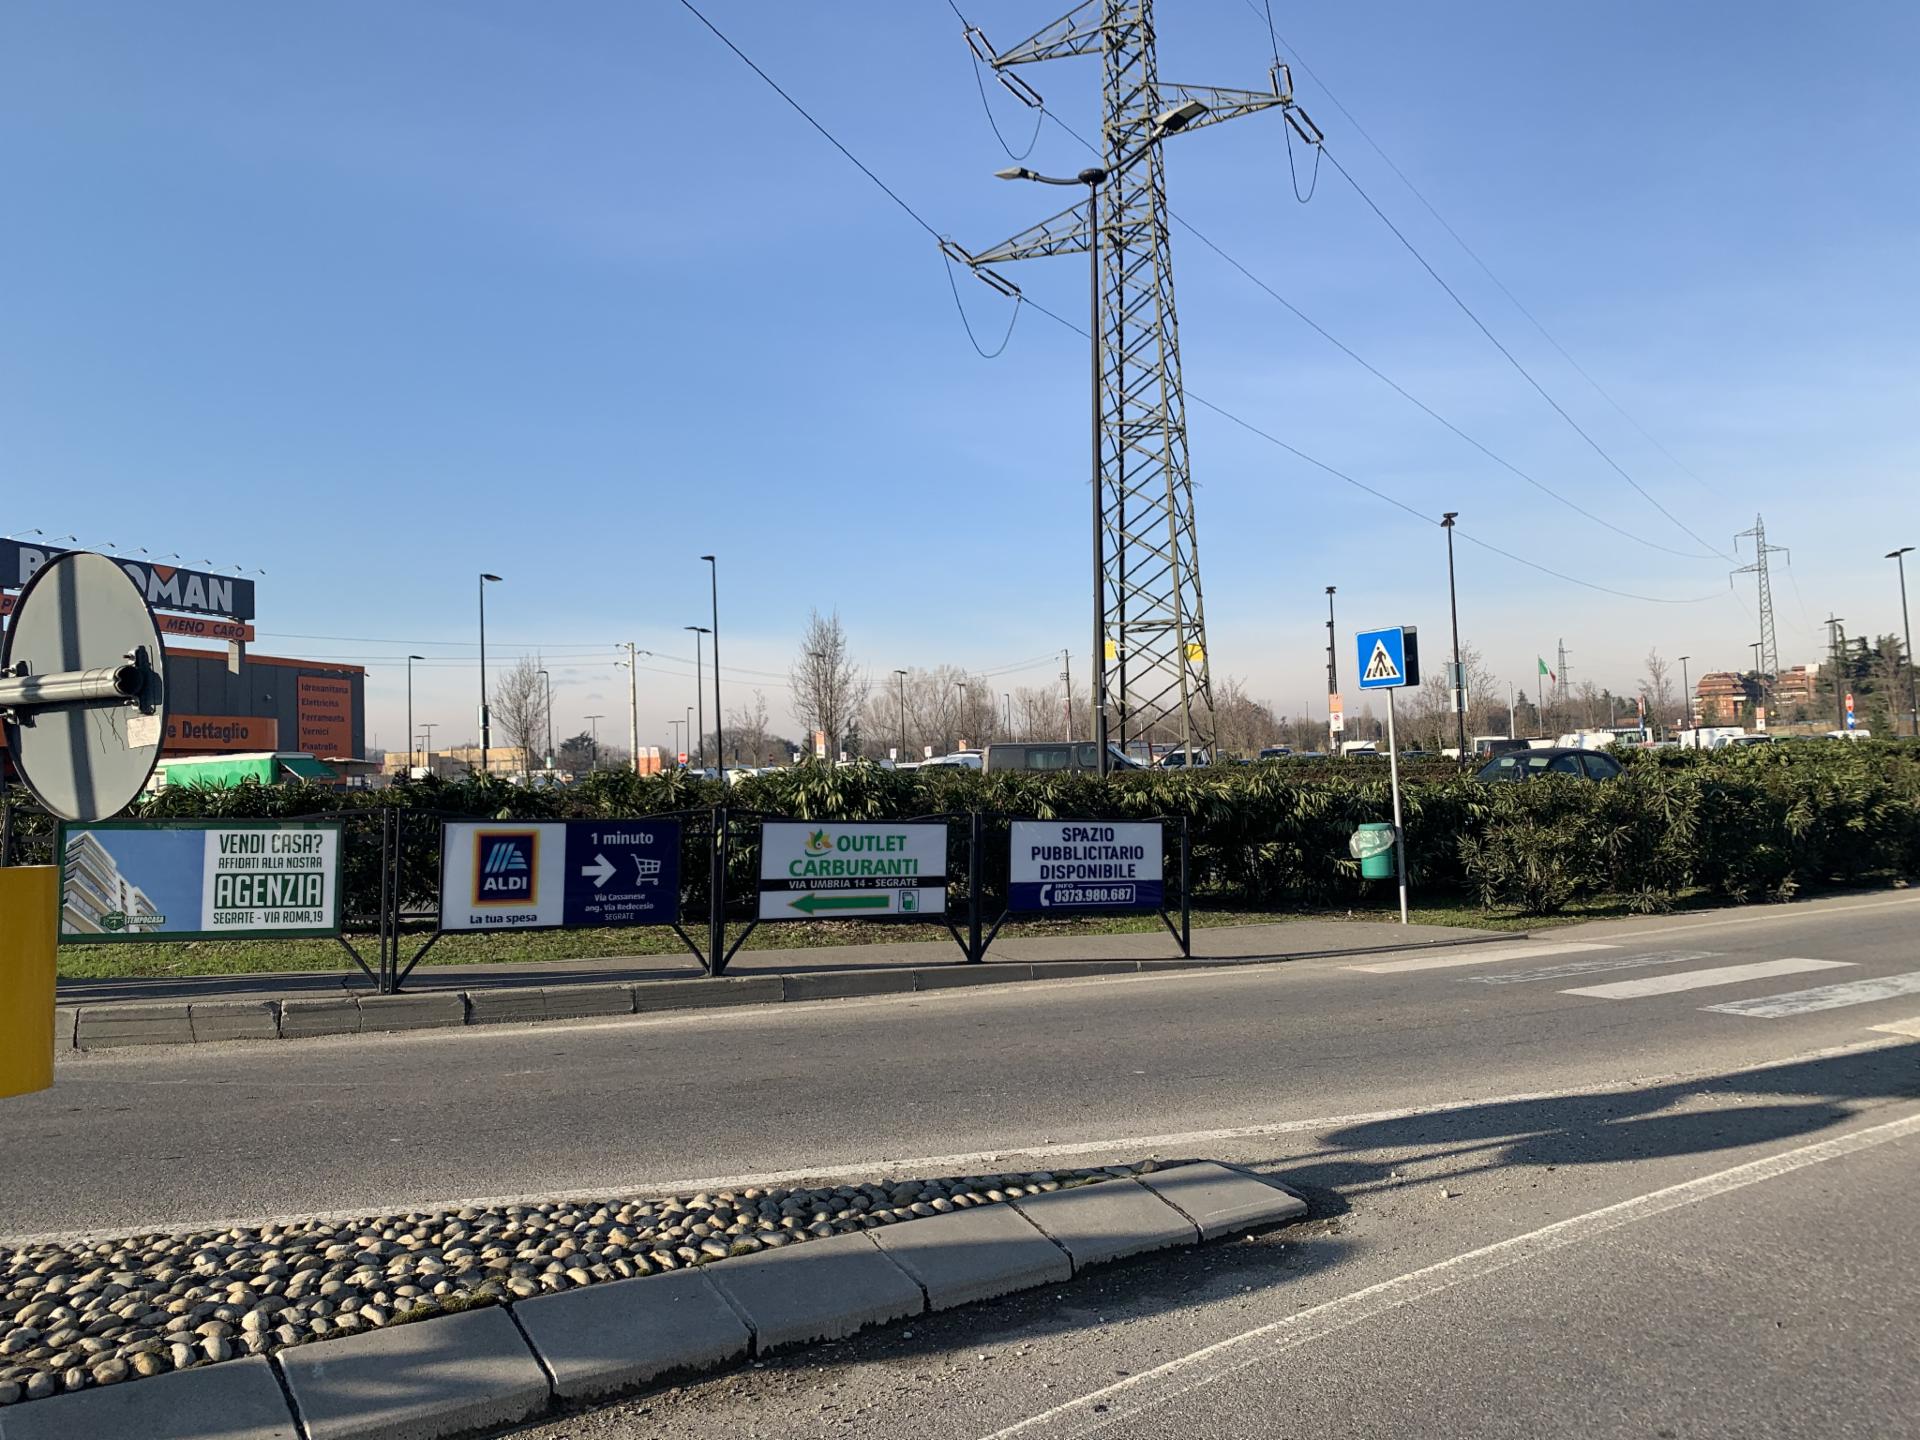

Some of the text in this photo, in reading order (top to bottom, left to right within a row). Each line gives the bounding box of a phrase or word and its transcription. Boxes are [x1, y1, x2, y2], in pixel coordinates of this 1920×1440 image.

[166, 618, 245, 638] MENO CARO
[182, 720, 249, 744] Dettaglio
[302, 727, 329, 736] Vernici
[591, 831, 654, 845] 1 minuto
[1062, 827, 1114, 842] SPAZIO
[219, 832, 324, 854] VENDI CASA?
[836, 835, 907, 852] OUTLET
[1031, 845, 1144, 861] PUBBLICITARIO
[218, 856, 323, 869] AFFIDATI ALLA NOSTRA
[789, 858, 918, 877] CARBURANTI
[1040, 863, 1136, 880] DISPONIBILE
[216, 874, 322, 908] AGENZIA
[483, 876, 528, 891] ALDI
[789, 880, 807, 889] VIA
[810, 879, 850, 889] UMBRIA
[854, 880, 865, 888] 14
[875, 878, 918, 887] SEGRATE
[594, 893, 646, 902] Via Cassanese
[1054, 888, 1131, 903] 0373.980.687
[603, 903, 615, 911] Via
[127, 916, 165, 924] TEMPOCASA
[213, 911, 255, 925] SEGRATE
[263, 911, 281, 924] VIA
[470, 913, 538, 926] La tua spesa
[605, 912, 635, 920] SEGRATE
